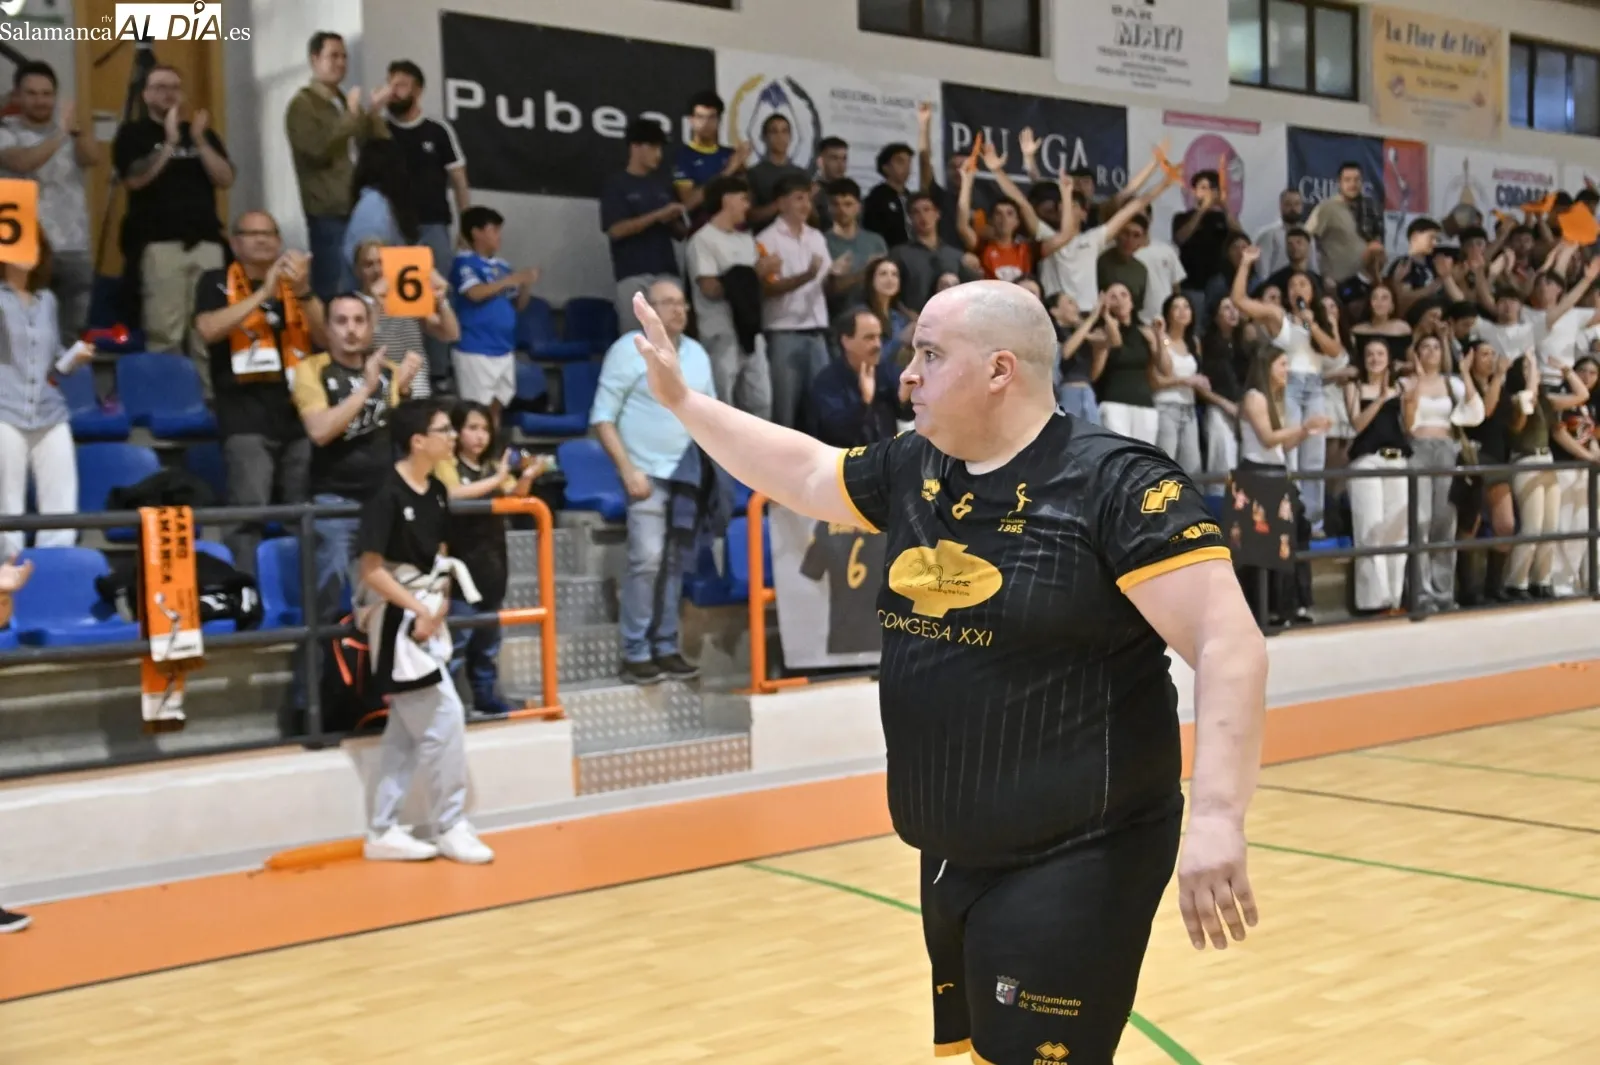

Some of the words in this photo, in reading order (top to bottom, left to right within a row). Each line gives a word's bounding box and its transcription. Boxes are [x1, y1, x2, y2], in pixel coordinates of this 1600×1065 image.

[1111, 4, 1153, 20] BAR
[1441, 30, 1457, 53] de
[950, 122, 1089, 175] PUGA
[0, 203, 22, 245] 6
[396, 265, 423, 302] 6
[952, 492, 974, 520] 6
[997, 524, 1023, 534] 1995
[847, 537, 868, 589] 6
[877, 609, 951, 642] CONGESA
[958, 626, 993, 646] XXI
[1018, 1001, 1028, 1010] de
[1030, 1003, 1079, 1016] Salamanca
[1019, 990, 1082, 1007] Ayuntamiento
